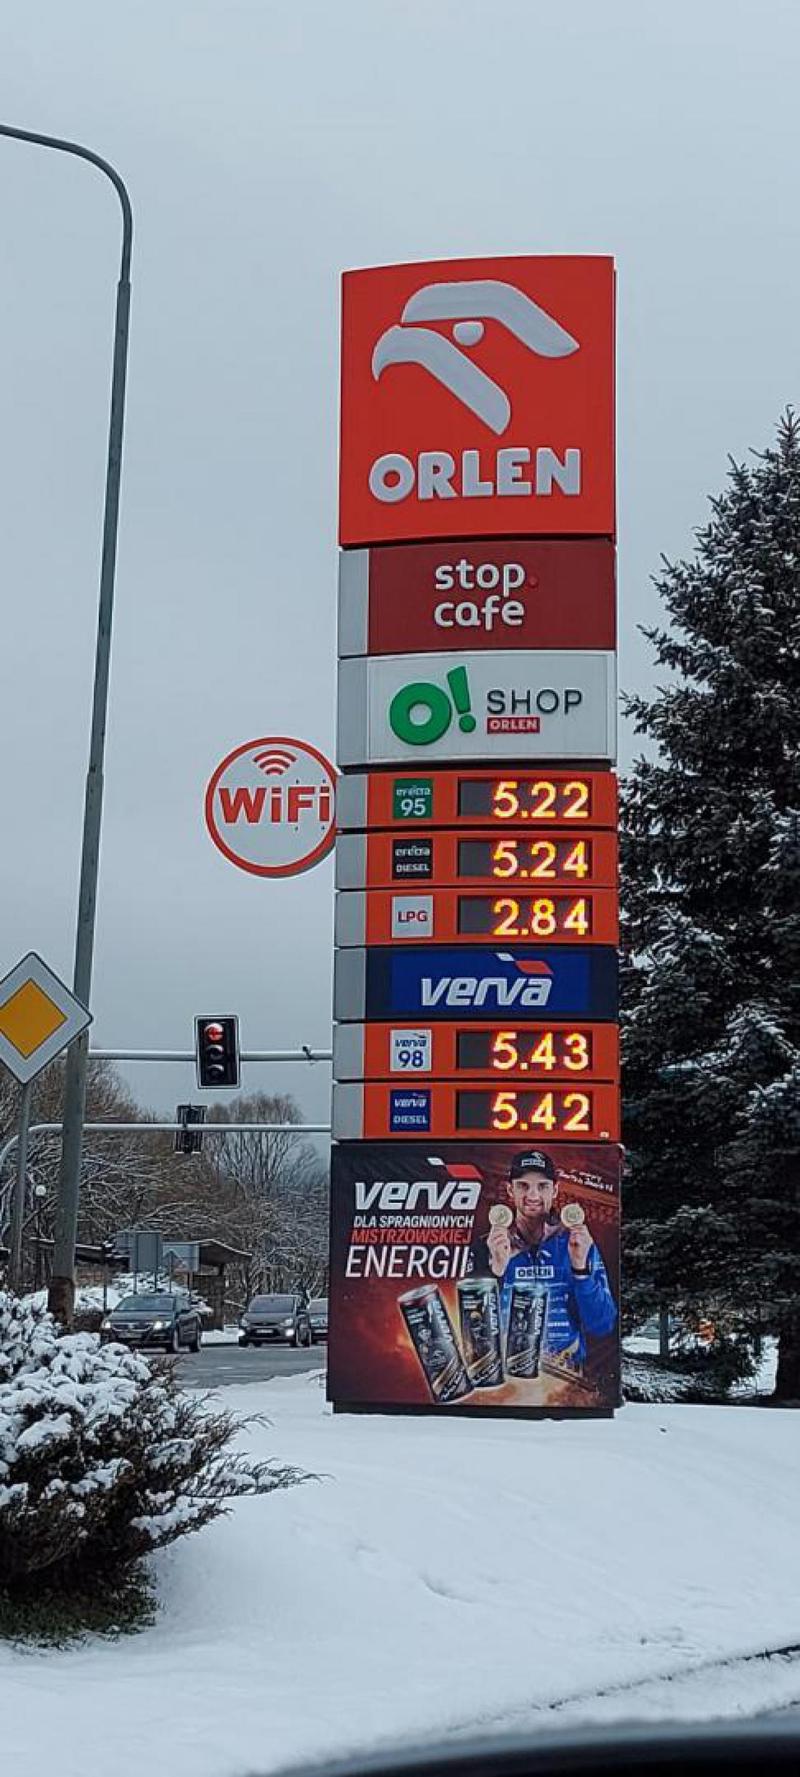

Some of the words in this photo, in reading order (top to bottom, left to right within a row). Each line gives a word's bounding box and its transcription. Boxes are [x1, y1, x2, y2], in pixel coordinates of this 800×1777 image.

[368, 447, 581, 503] ORLEN
[434, 559, 526, 597] stop
[434, 596, 526, 631] cafe
[486, 688, 584, 715] SHOP
[489, 719, 539, 731] ORLEN
[218, 785, 331, 824] WiFi
[401, 798, 427, 817] 95
[493, 781, 590, 819] 5.22
[396, 863, 430, 873] DIESEL
[493, 840, 589, 878] 5.24
[397, 910, 429, 923] LPG
[493, 898, 590, 936] 2.84
[421, 977, 552, 1006] verva
[395, 1039, 427, 1048] verva
[493, 1031, 590, 1071] 5.43
[398, 1050, 424, 1068] 98
[394, 1098, 426, 1108] verva
[493, 1092, 590, 1131] 5.42
[393, 1114, 427, 1124] DIESEL
[355, 1182, 482, 1210] verva
[353, 1215, 377, 1229] DLA
[379, 1214, 475, 1229] SPRAGNIONYCH
[351, 1228, 472, 1244] MISTRZOWSKIEJ
[345, 1245, 470, 1278] ENERGII
